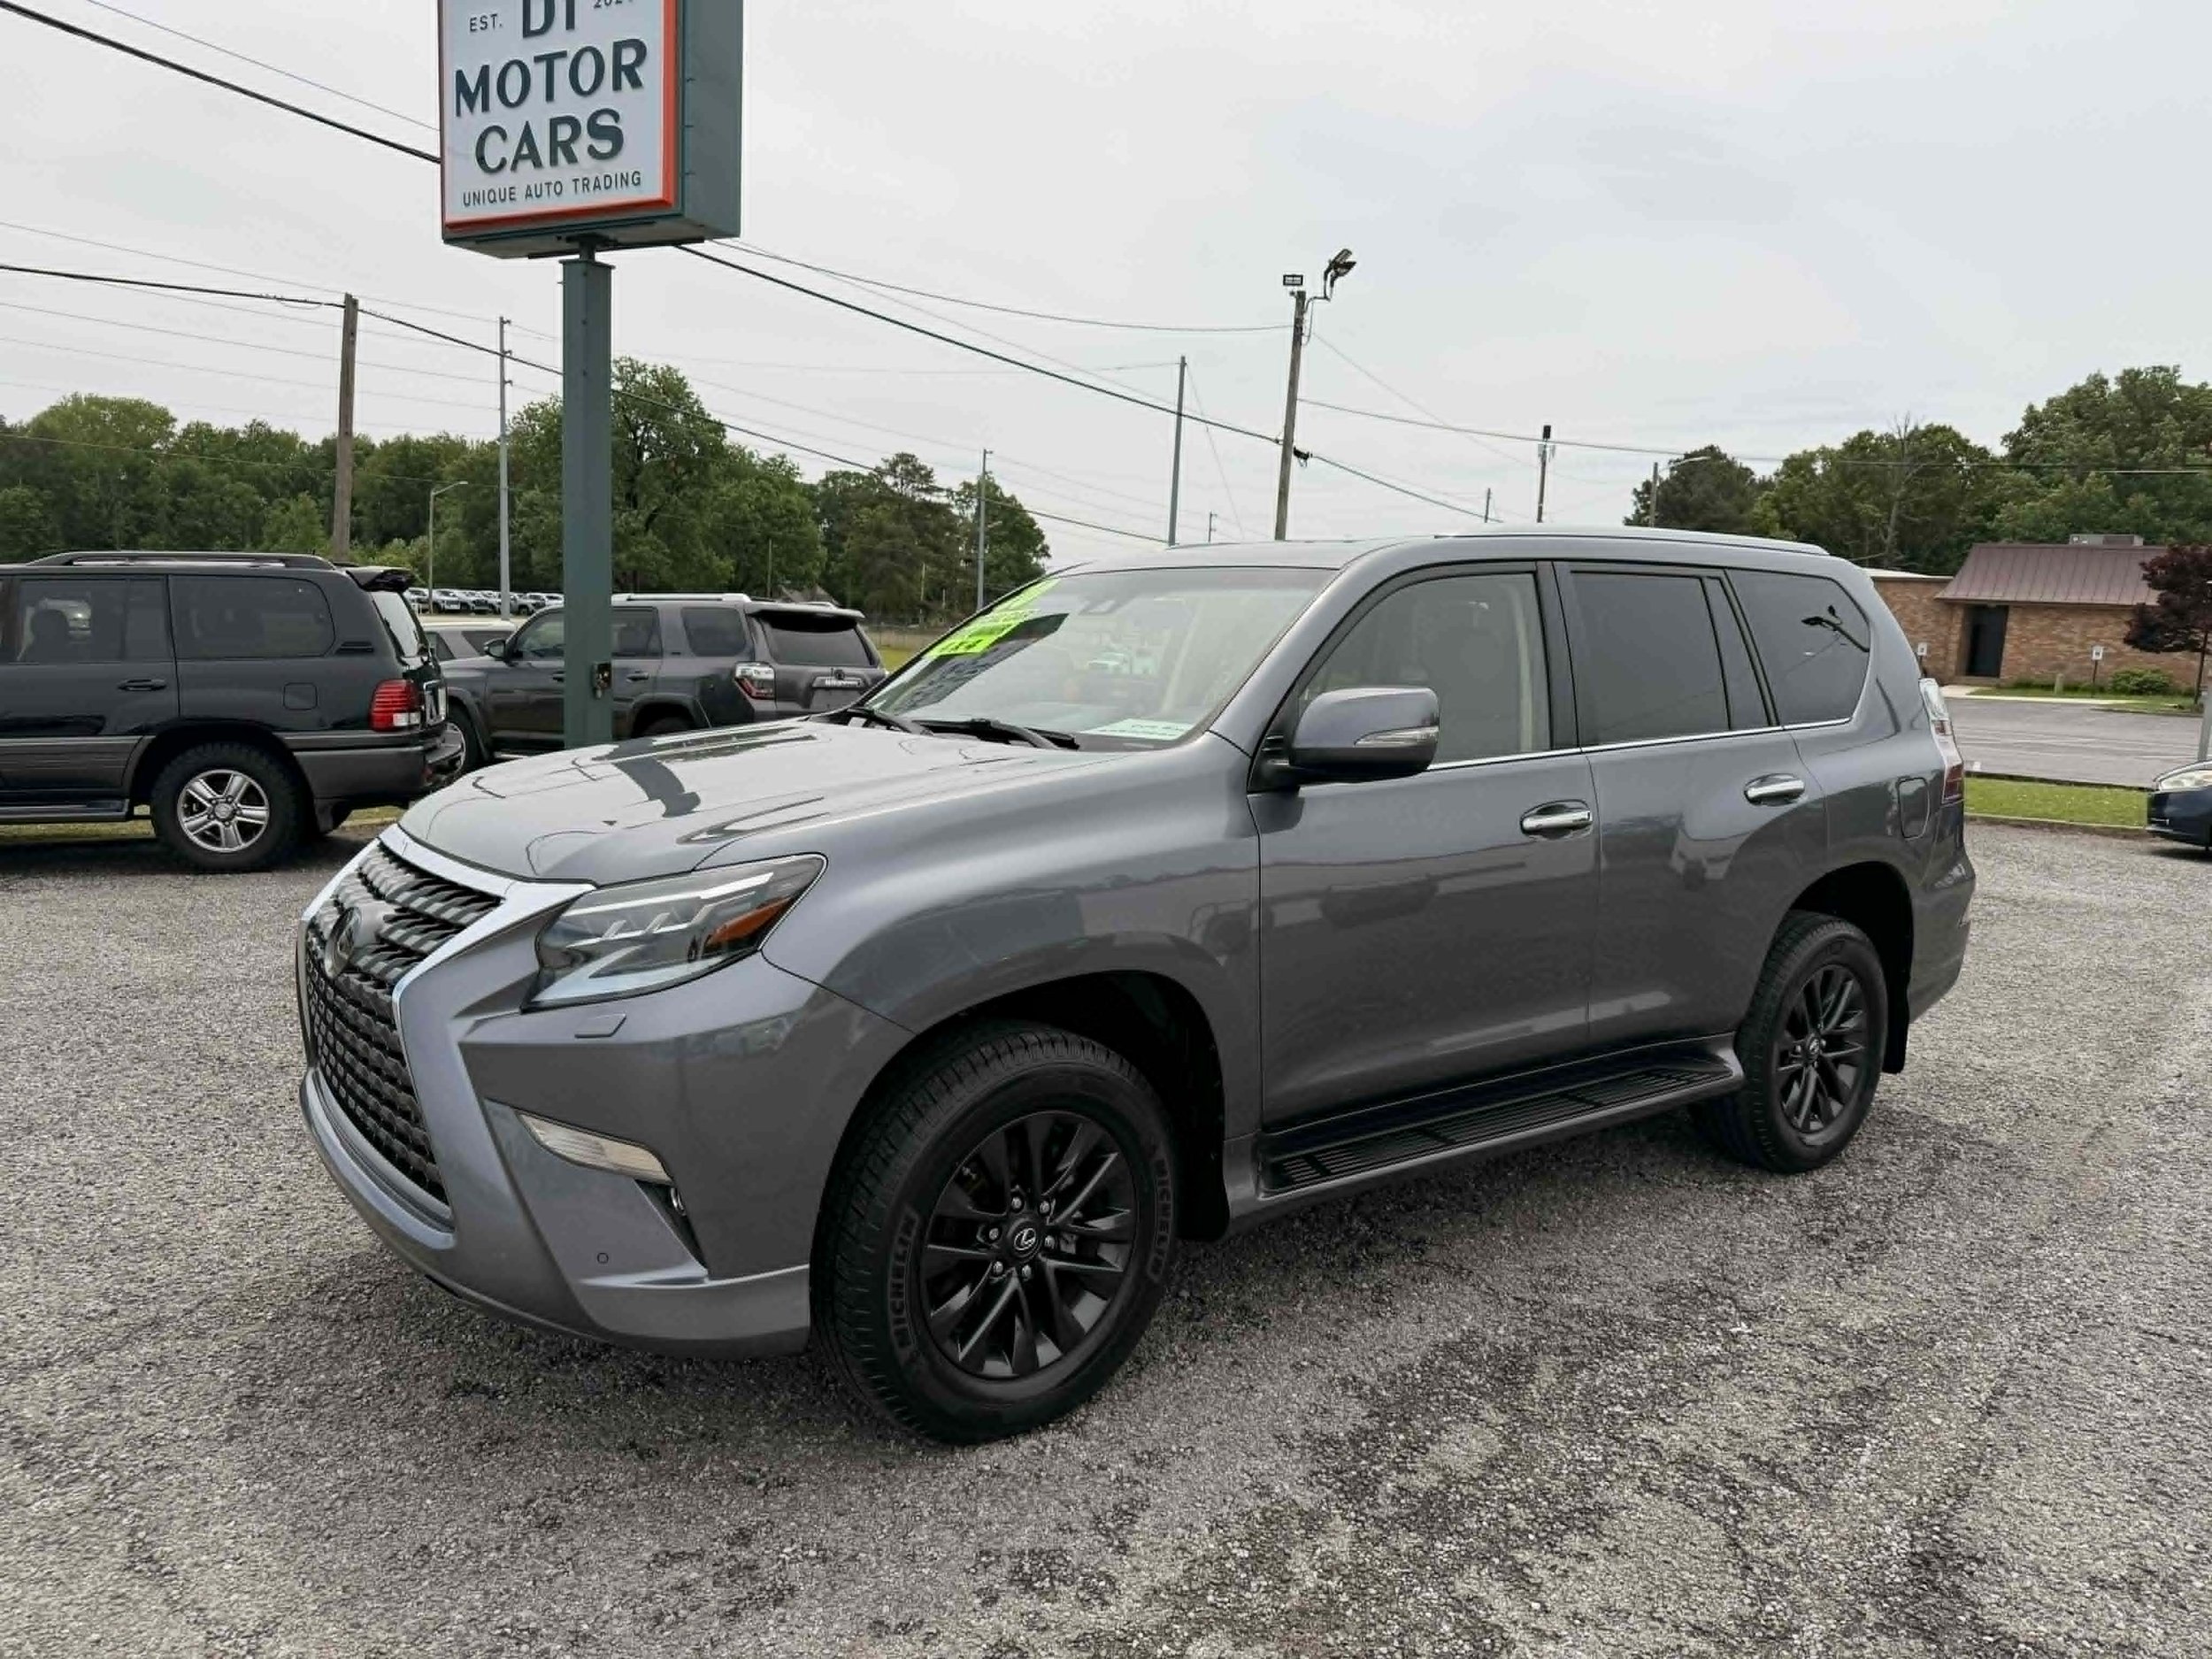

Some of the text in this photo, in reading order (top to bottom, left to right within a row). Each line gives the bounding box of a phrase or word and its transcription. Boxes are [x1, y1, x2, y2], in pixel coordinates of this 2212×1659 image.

[470, 13, 503, 32] EST.
[455, 38, 648, 118] MOTOR
[475, 108, 624, 174] CARS
[463, 171, 641, 207] UNIQUE AUTO TRADING
[889, 1215, 916, 1348] MICHELIN
